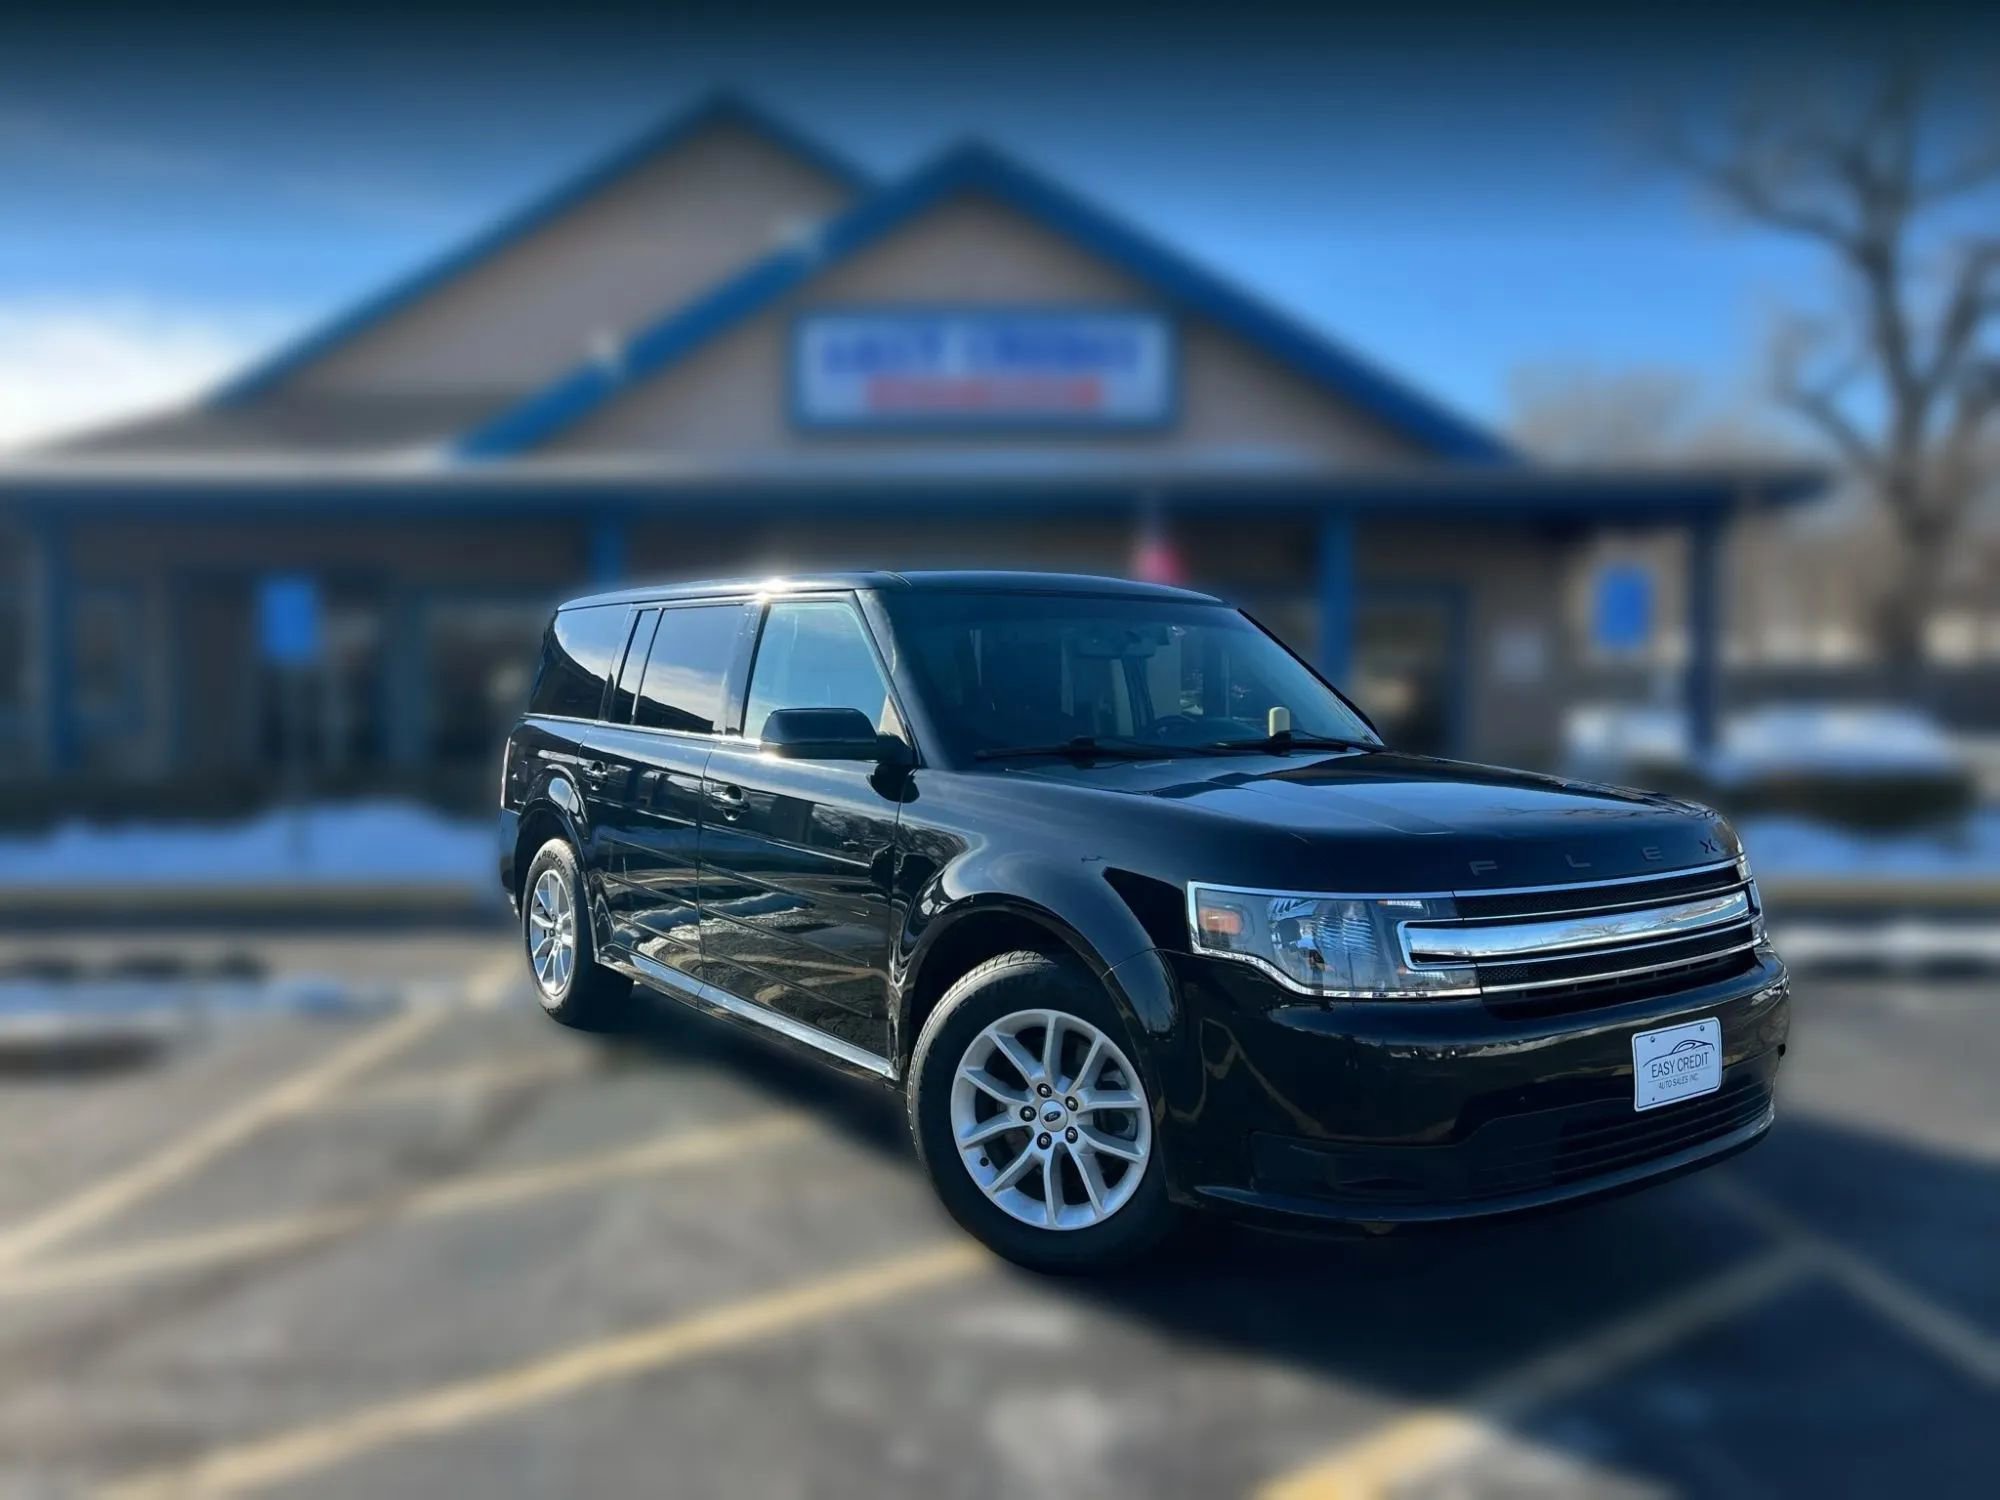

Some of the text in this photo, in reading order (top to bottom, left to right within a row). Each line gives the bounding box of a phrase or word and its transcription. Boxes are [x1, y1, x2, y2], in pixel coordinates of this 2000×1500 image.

[1468, 839, 1718, 877] FLEX
[1651, 1052, 1709, 1078] EASY CREDIT
[1658, 1080, 1672, 1089] AUTO
[1673, 1075, 1688, 1086] SALES
